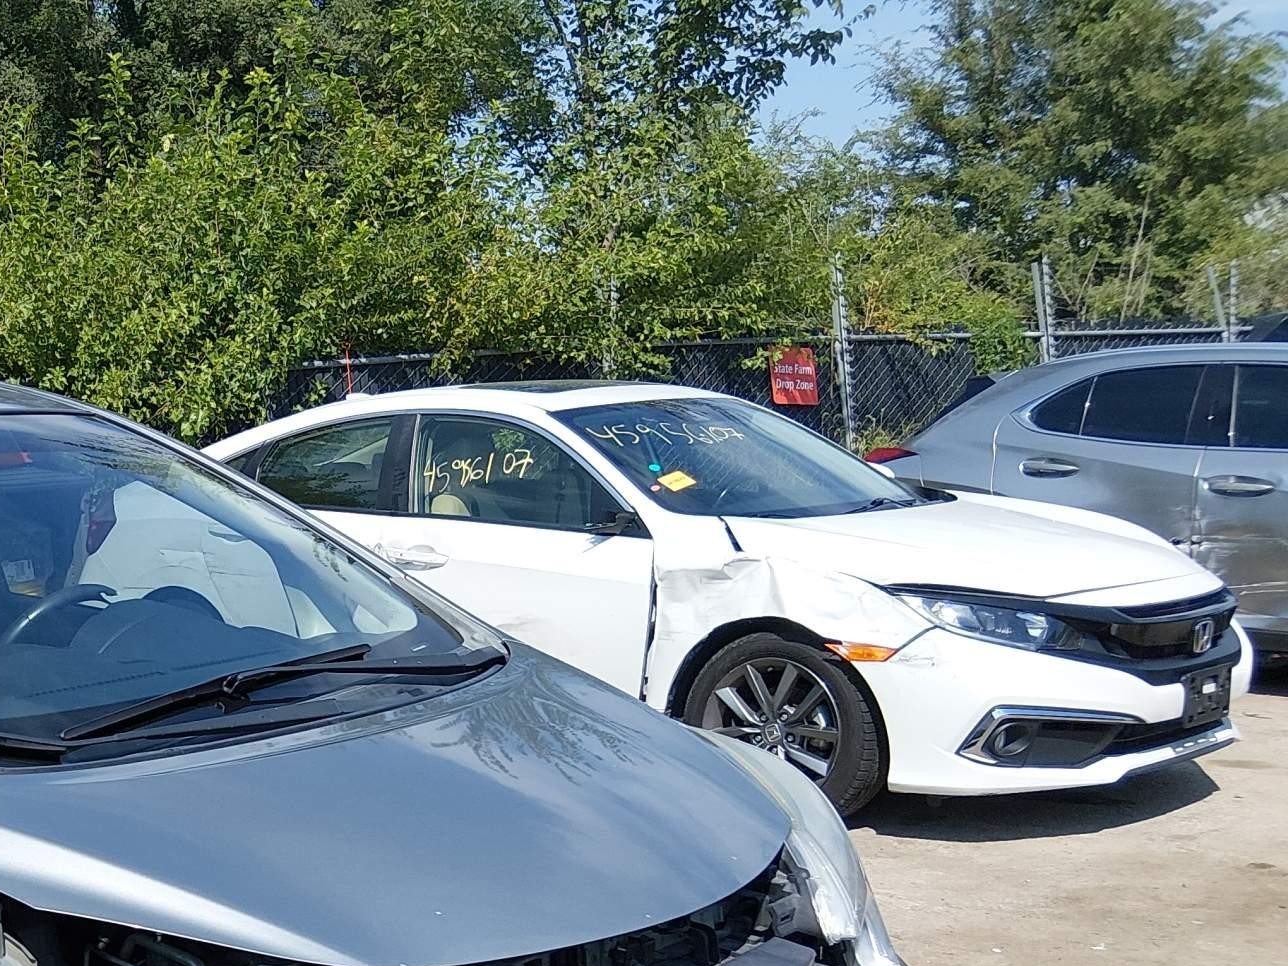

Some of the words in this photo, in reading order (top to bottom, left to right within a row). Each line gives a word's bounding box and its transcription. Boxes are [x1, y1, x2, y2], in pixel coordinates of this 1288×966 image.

[774, 363, 793, 374] State
[795, 364, 813, 375] Farm
[776, 379, 794, 392] Drop
[796, 380, 814, 390] Zone
